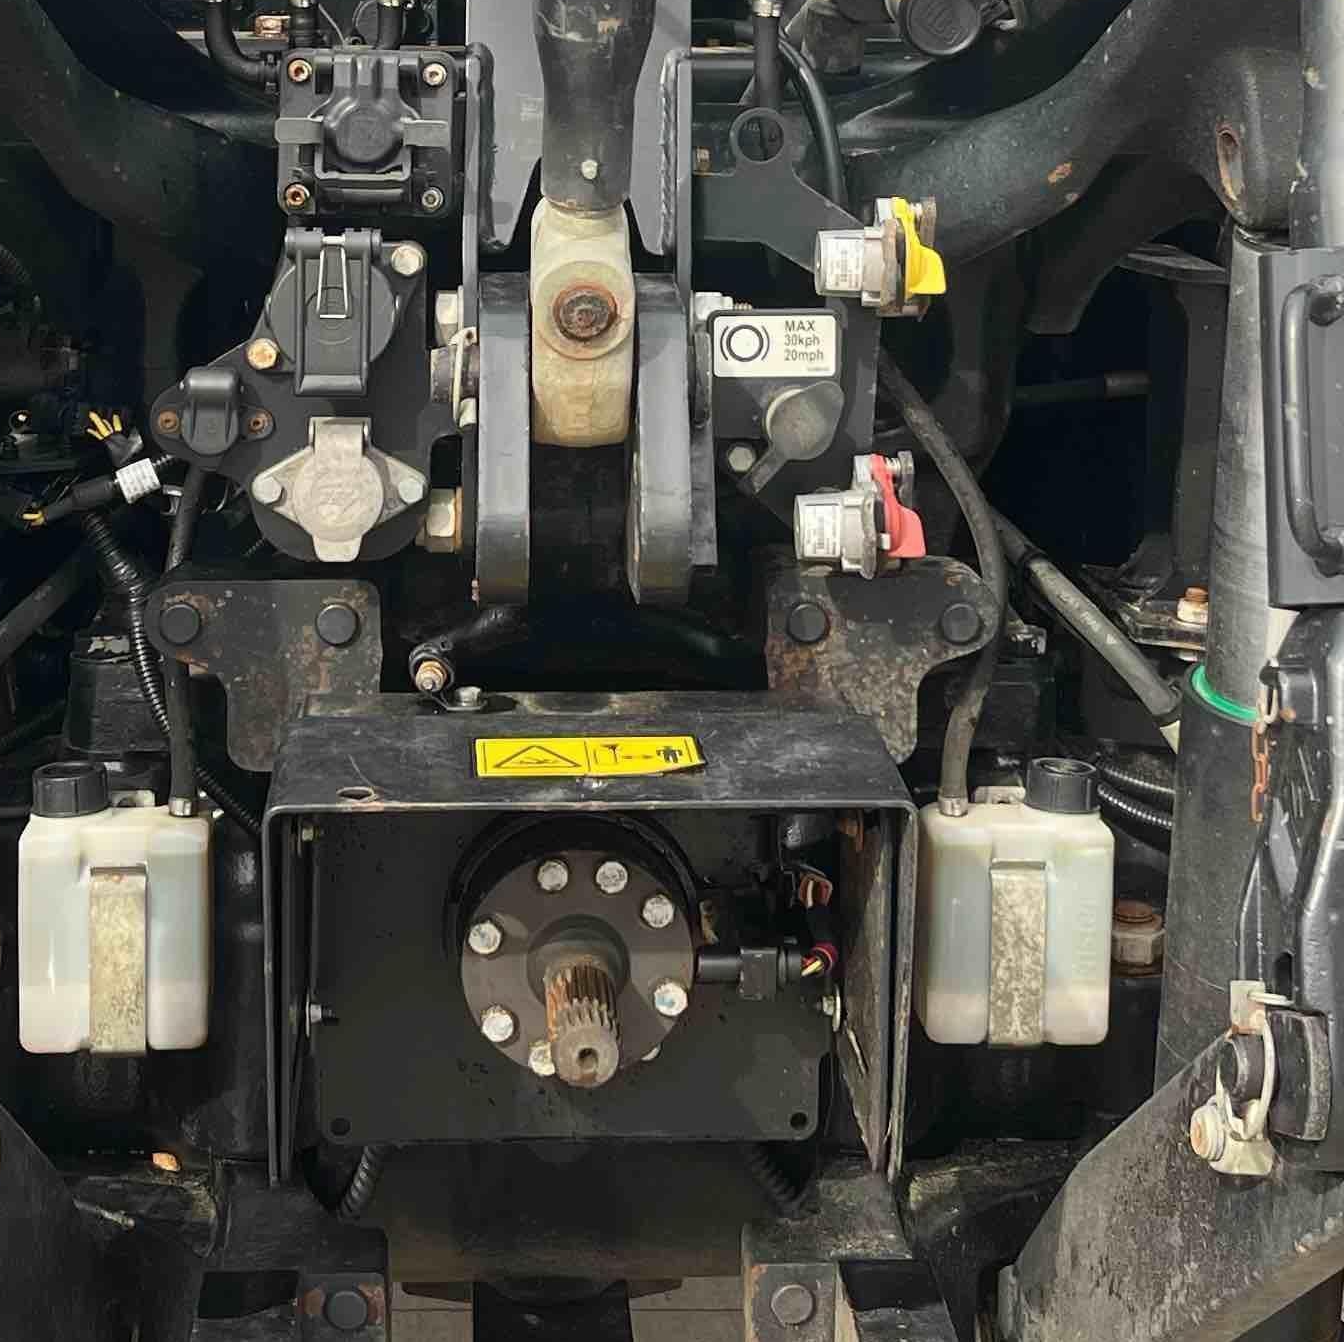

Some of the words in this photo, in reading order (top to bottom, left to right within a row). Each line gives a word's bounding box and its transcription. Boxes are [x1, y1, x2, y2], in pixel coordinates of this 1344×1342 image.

[784, 320, 816, 331] MAX
[784, 334, 820, 347] 30kph
[784, 349, 824, 362] 20mph
